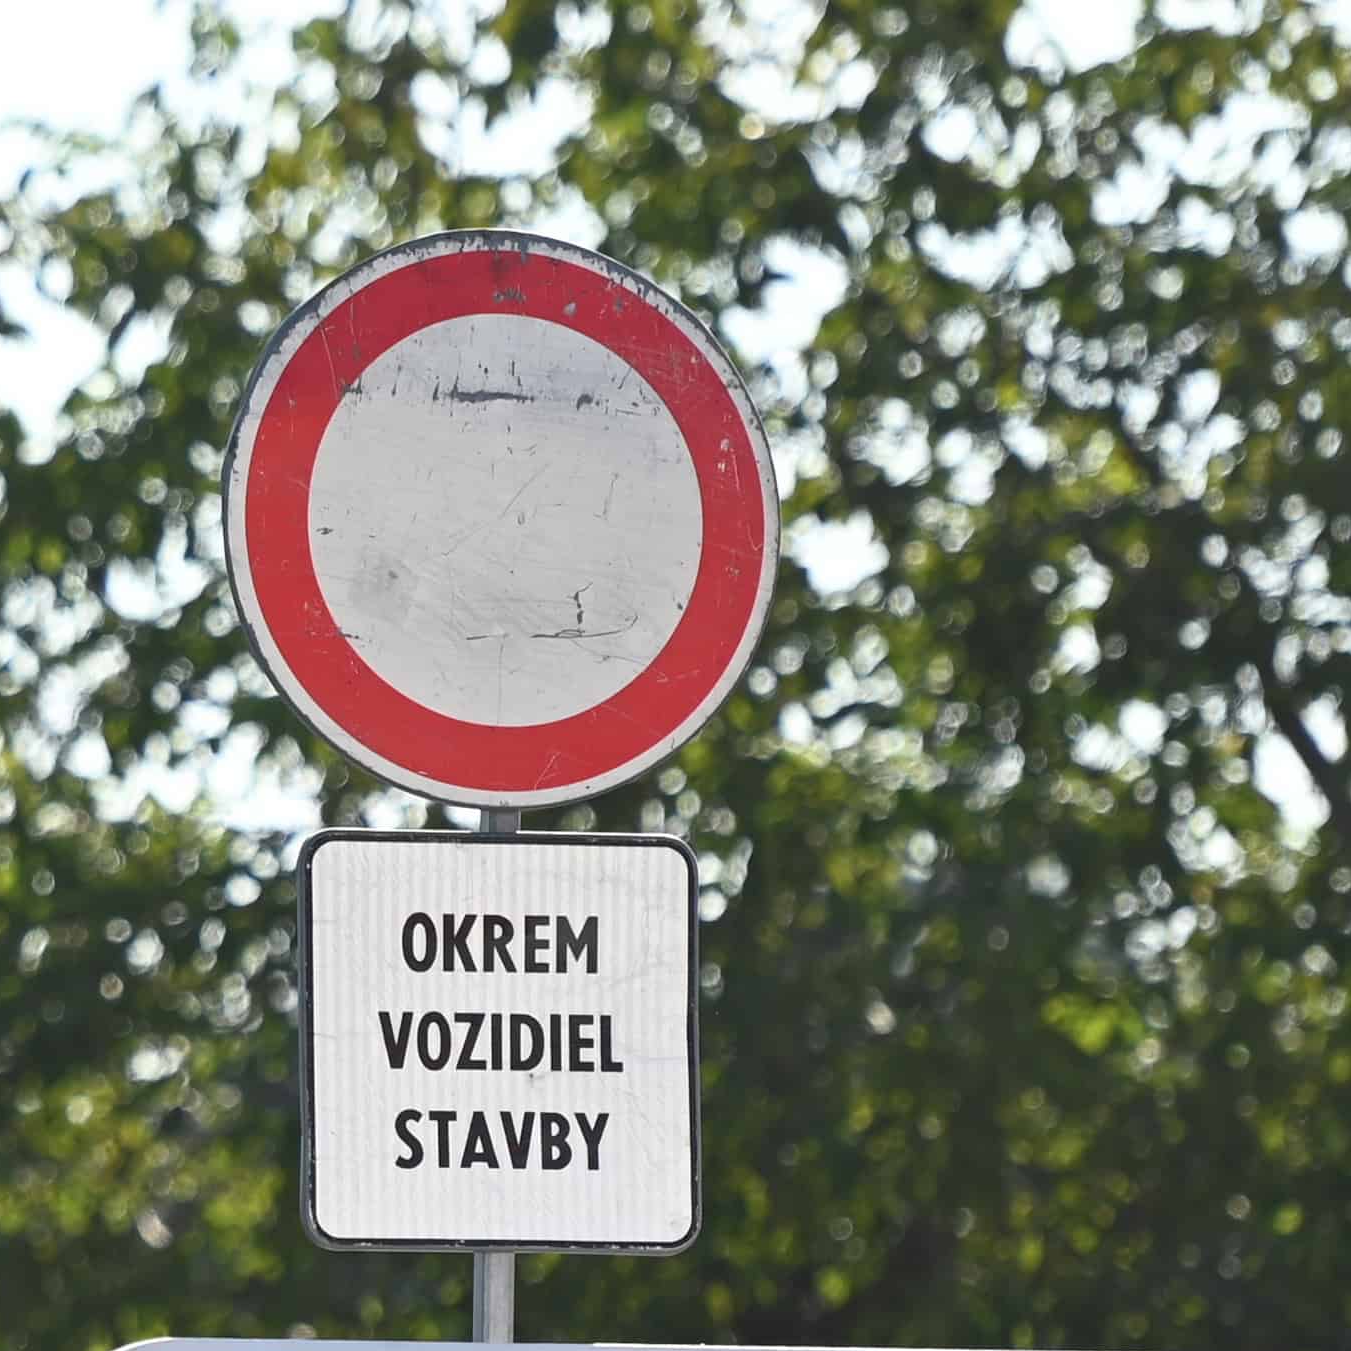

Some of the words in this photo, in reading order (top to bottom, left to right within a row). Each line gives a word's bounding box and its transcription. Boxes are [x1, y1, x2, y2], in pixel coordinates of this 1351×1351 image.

[401, 911, 599, 974] OKREM
[378, 1010, 624, 1073] VOZIDIEL
[394, 1108, 610, 1170] STAVBY
